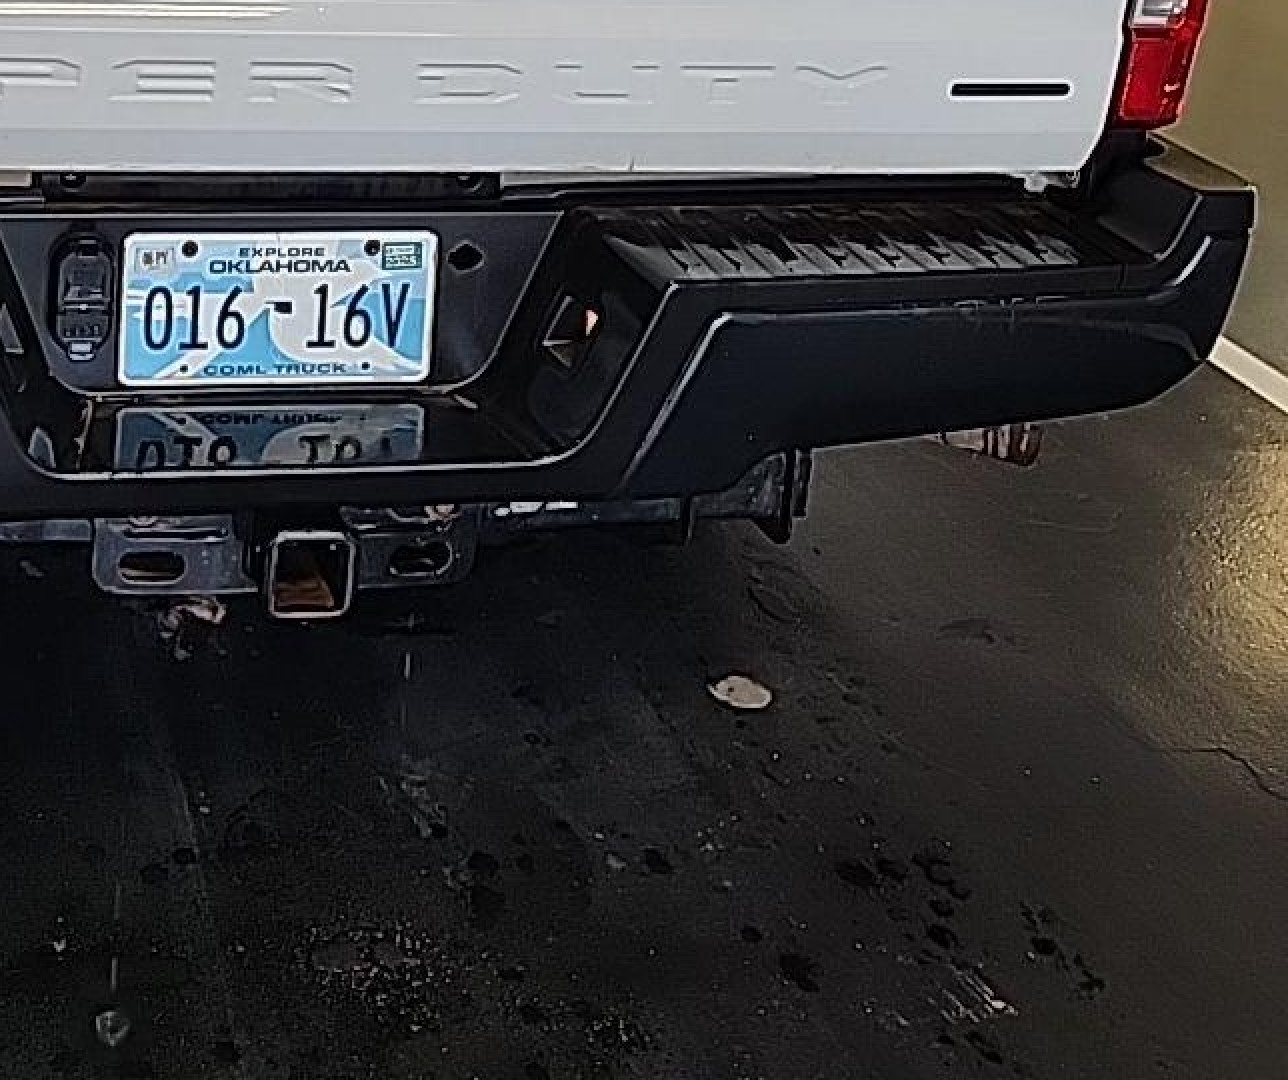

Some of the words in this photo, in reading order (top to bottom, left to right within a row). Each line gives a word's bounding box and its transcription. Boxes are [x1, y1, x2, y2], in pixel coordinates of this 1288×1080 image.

[413, 61, 890, 105] DUTY
[239, 247, 326, 258] EXPLORE
[209, 259, 352, 275] OKLAHOMA
[203, 365, 267, 376] COML
[273, 363, 347, 375] TRUCK
